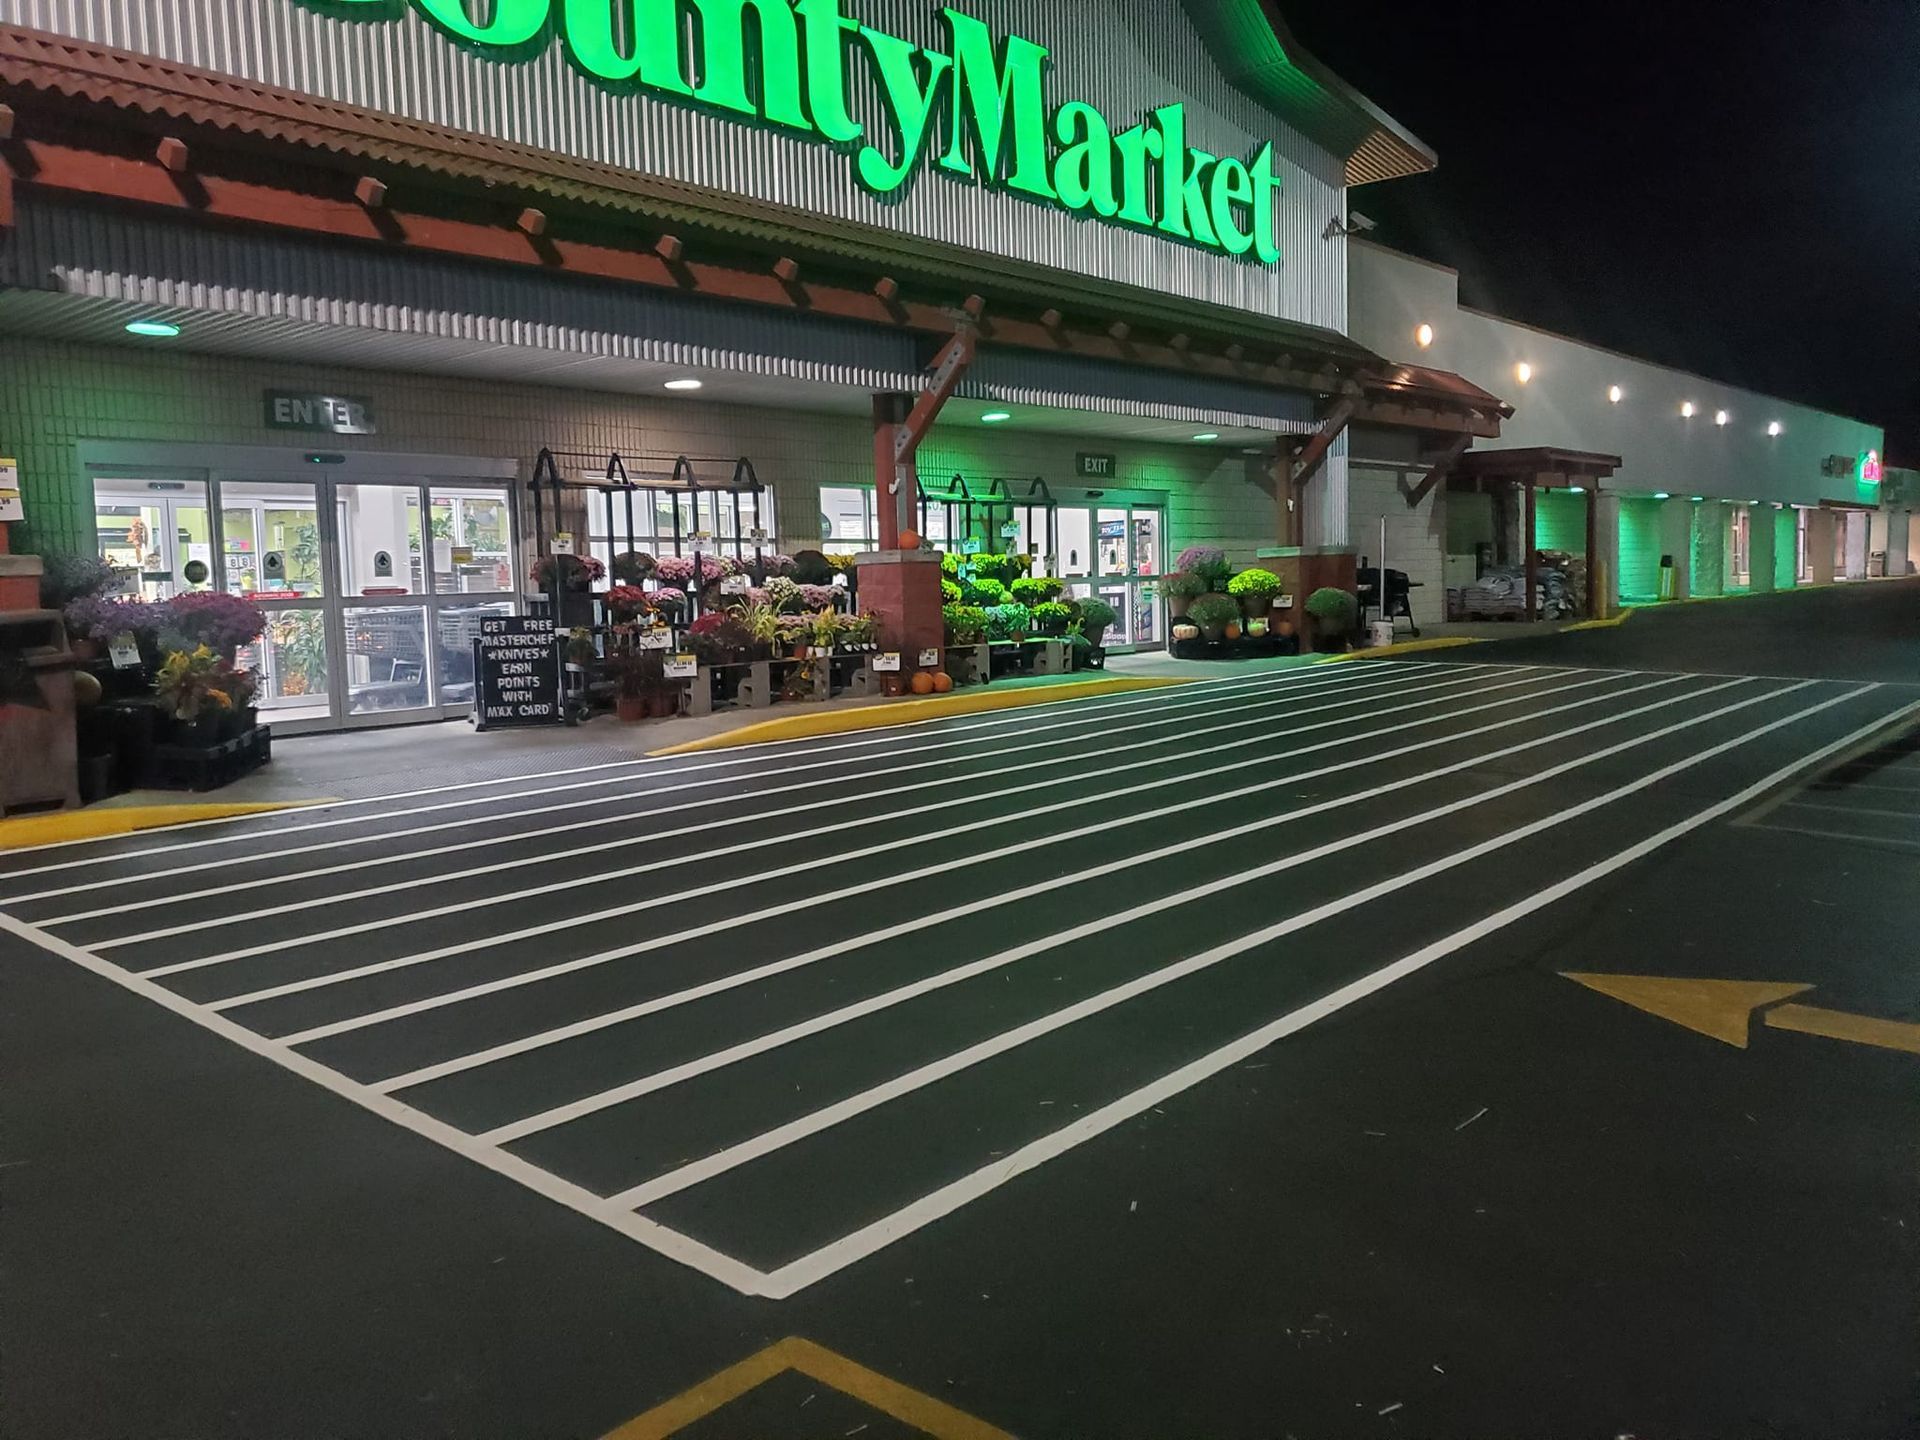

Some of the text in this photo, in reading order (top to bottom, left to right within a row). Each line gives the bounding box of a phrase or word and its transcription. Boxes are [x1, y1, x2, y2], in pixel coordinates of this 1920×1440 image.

[274, 397, 368, 426] ENTER
[1084, 457, 1108, 473] EXIT
[483, 619, 553, 633] GET FREE
[481, 633, 555, 647] MASTERCHEF
[502, 662, 532, 675] EARN
[497, 676, 540, 689] POINTS
[502, 690, 533, 702] WITH
[487, 703, 549, 718] MAX CARD
